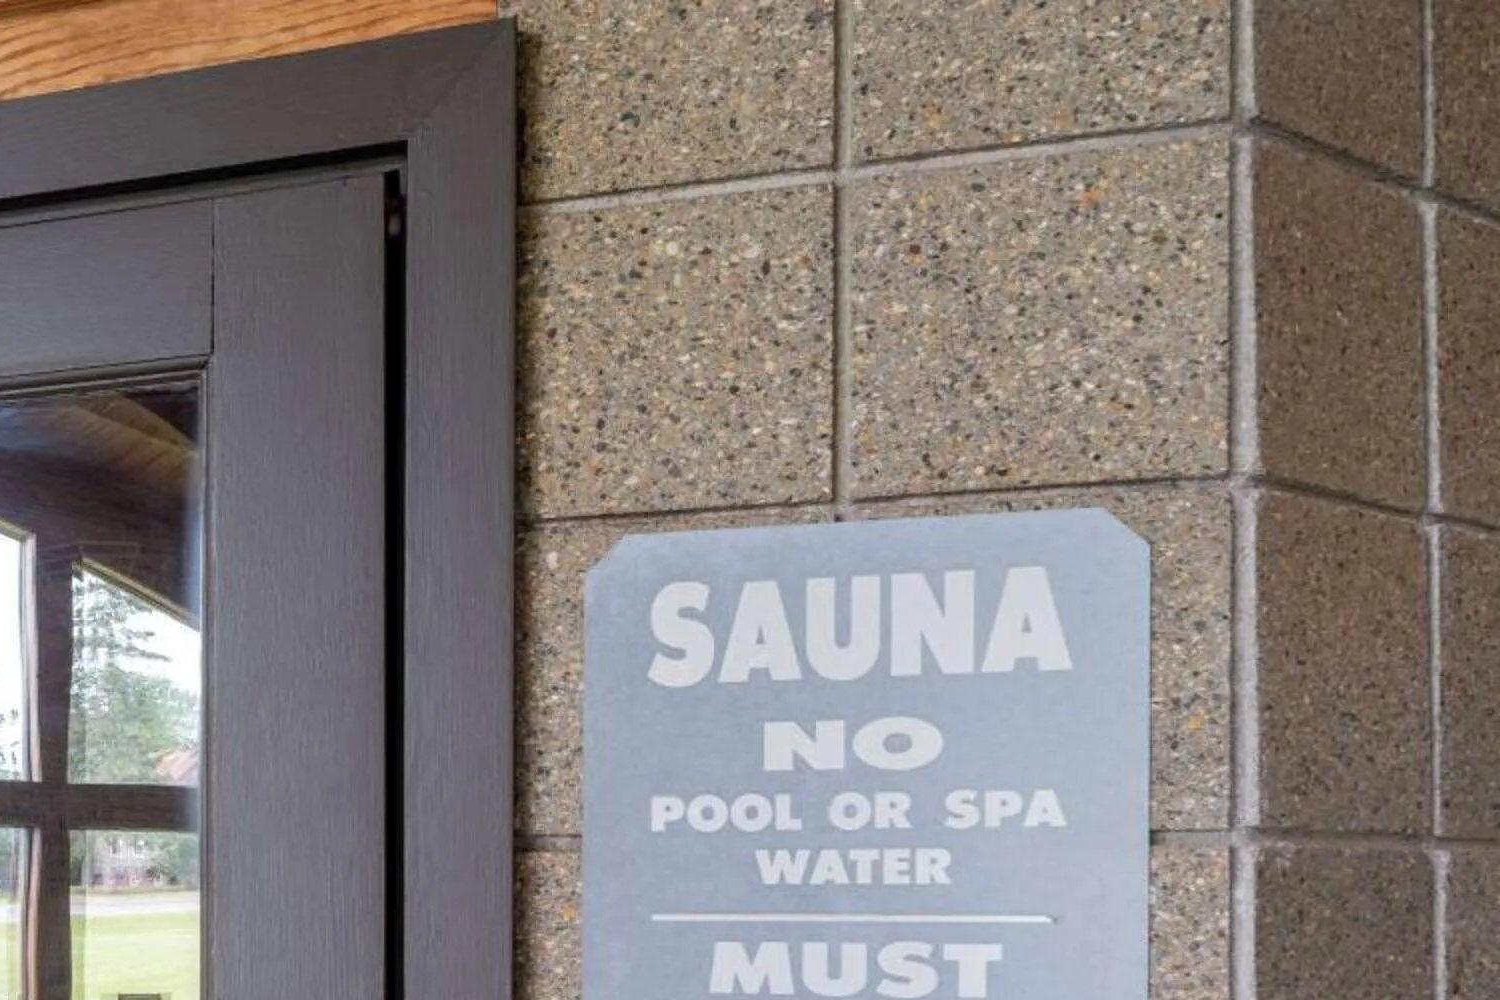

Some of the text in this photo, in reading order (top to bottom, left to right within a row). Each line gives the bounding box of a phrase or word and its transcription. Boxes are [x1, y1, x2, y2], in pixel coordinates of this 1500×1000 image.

[647, 565, 1073, 688] SAUNA
[762, 716, 943, 771] NO
[650, 790, 1068, 833] POOL OR SPA
[756, 848, 952, 886] WATER
[708, 941, 1004, 999] MUST
